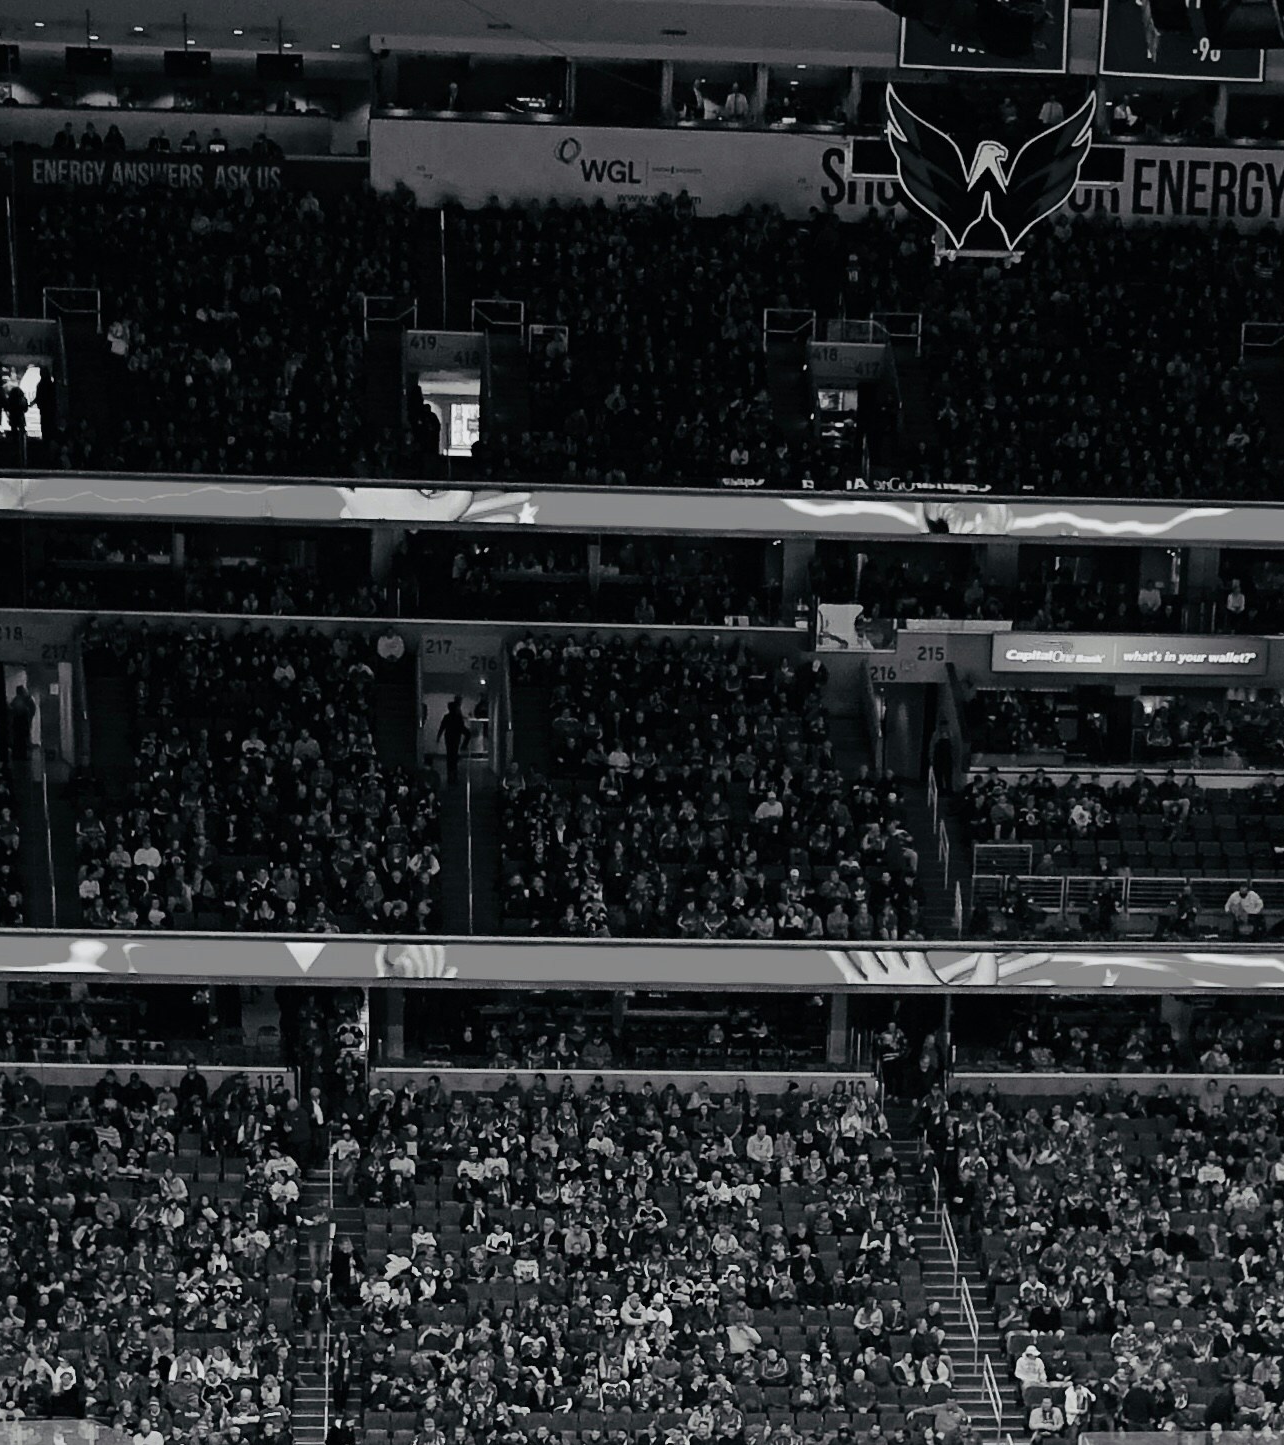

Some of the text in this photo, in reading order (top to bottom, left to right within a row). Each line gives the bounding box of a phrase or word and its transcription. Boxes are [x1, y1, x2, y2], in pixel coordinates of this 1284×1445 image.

[32, 158, 106, 185] ENERGY
[215, 163, 250, 190] ASK
[257, 165, 282, 190] US
[580, 159, 641, 184] WGL
[410, 335, 437, 350] 419
[426, 640, 452, 654] 217
[917, 646, 945, 662] 215
[471, 655, 497, 671] 216
[1076, 654, 1105, 664] Bank
[1123, 651, 1162, 663] what's
[1165, 652, 1175, 663] in
[1178, 654, 1207, 667] your
[870, 666, 896, 681] 216
